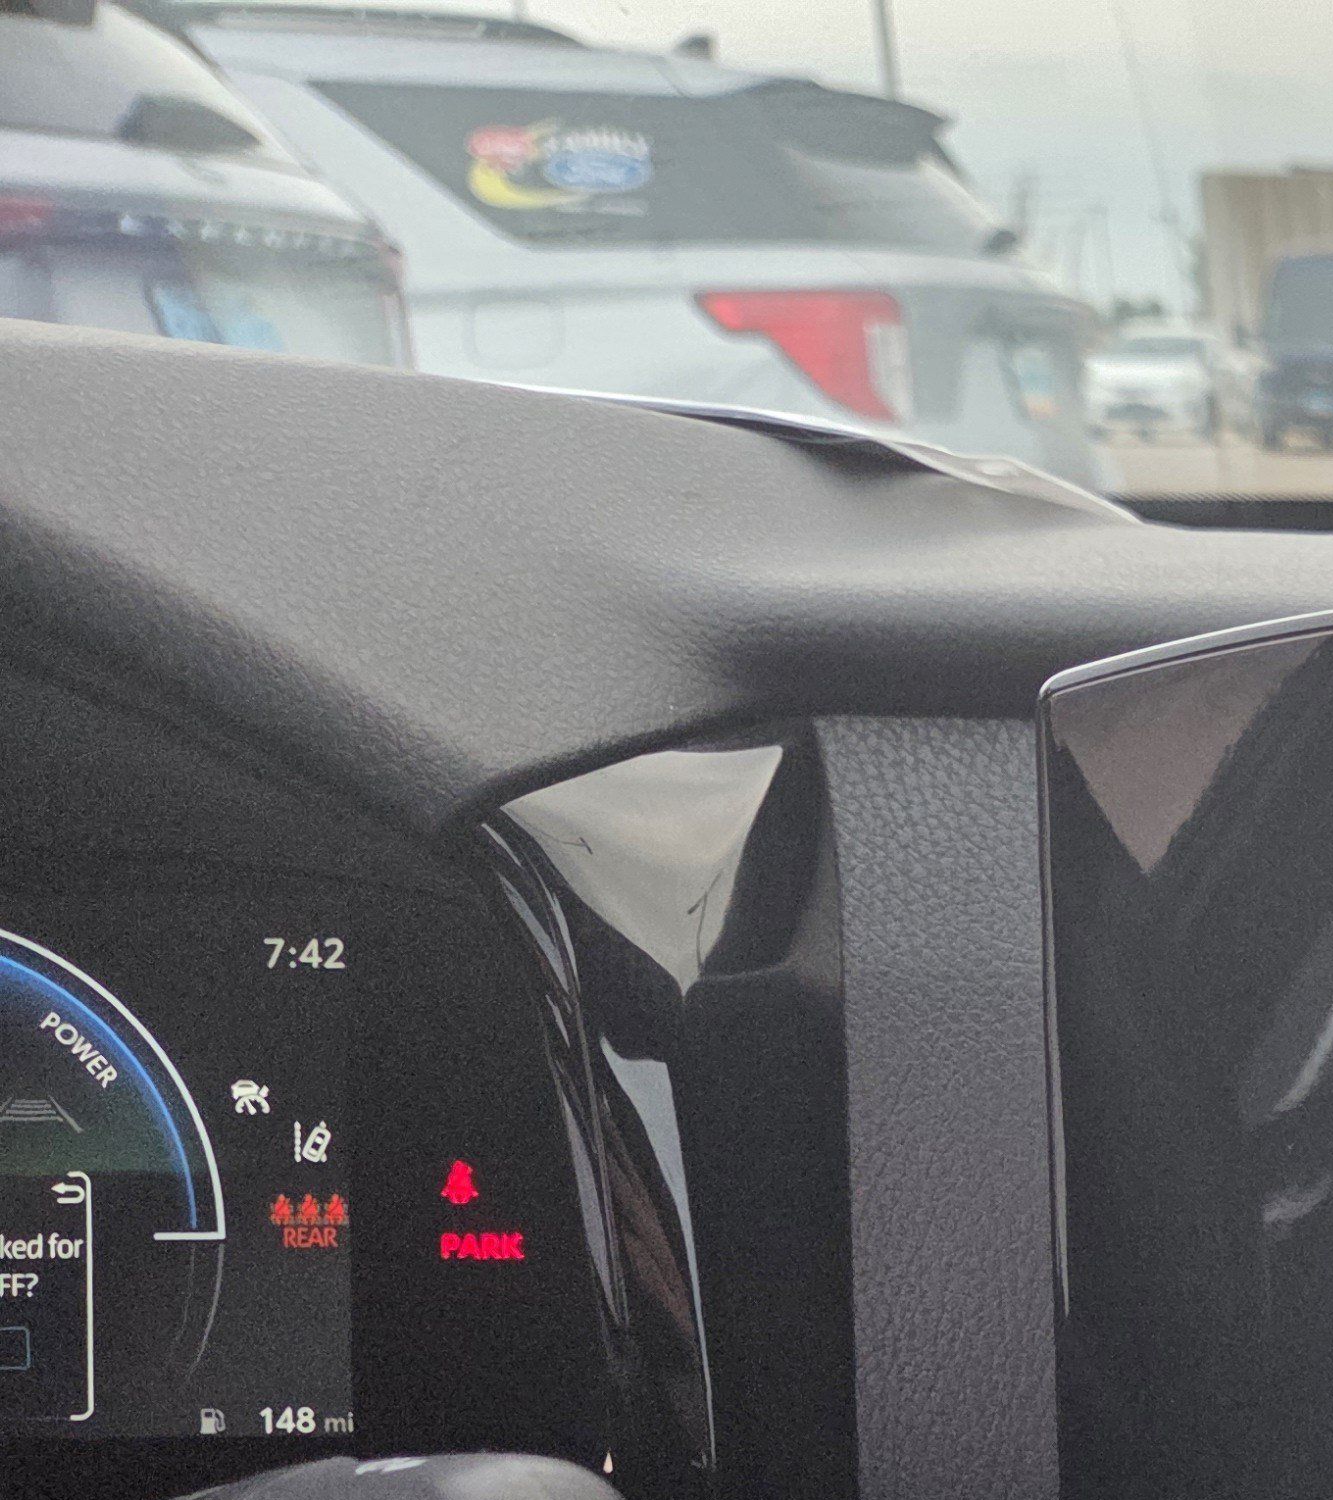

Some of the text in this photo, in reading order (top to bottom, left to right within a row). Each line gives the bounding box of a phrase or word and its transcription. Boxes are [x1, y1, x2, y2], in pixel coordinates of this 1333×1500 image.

[263, 937, 346, 969] 7:42
[39, 1011, 118, 1089] POWER
[47, 1232, 84, 1259] for
[283, 1228, 338, 1249] REAR
[440, 1231, 526, 1261] PARK
[259, 1406, 354, 1434] 148 mi
